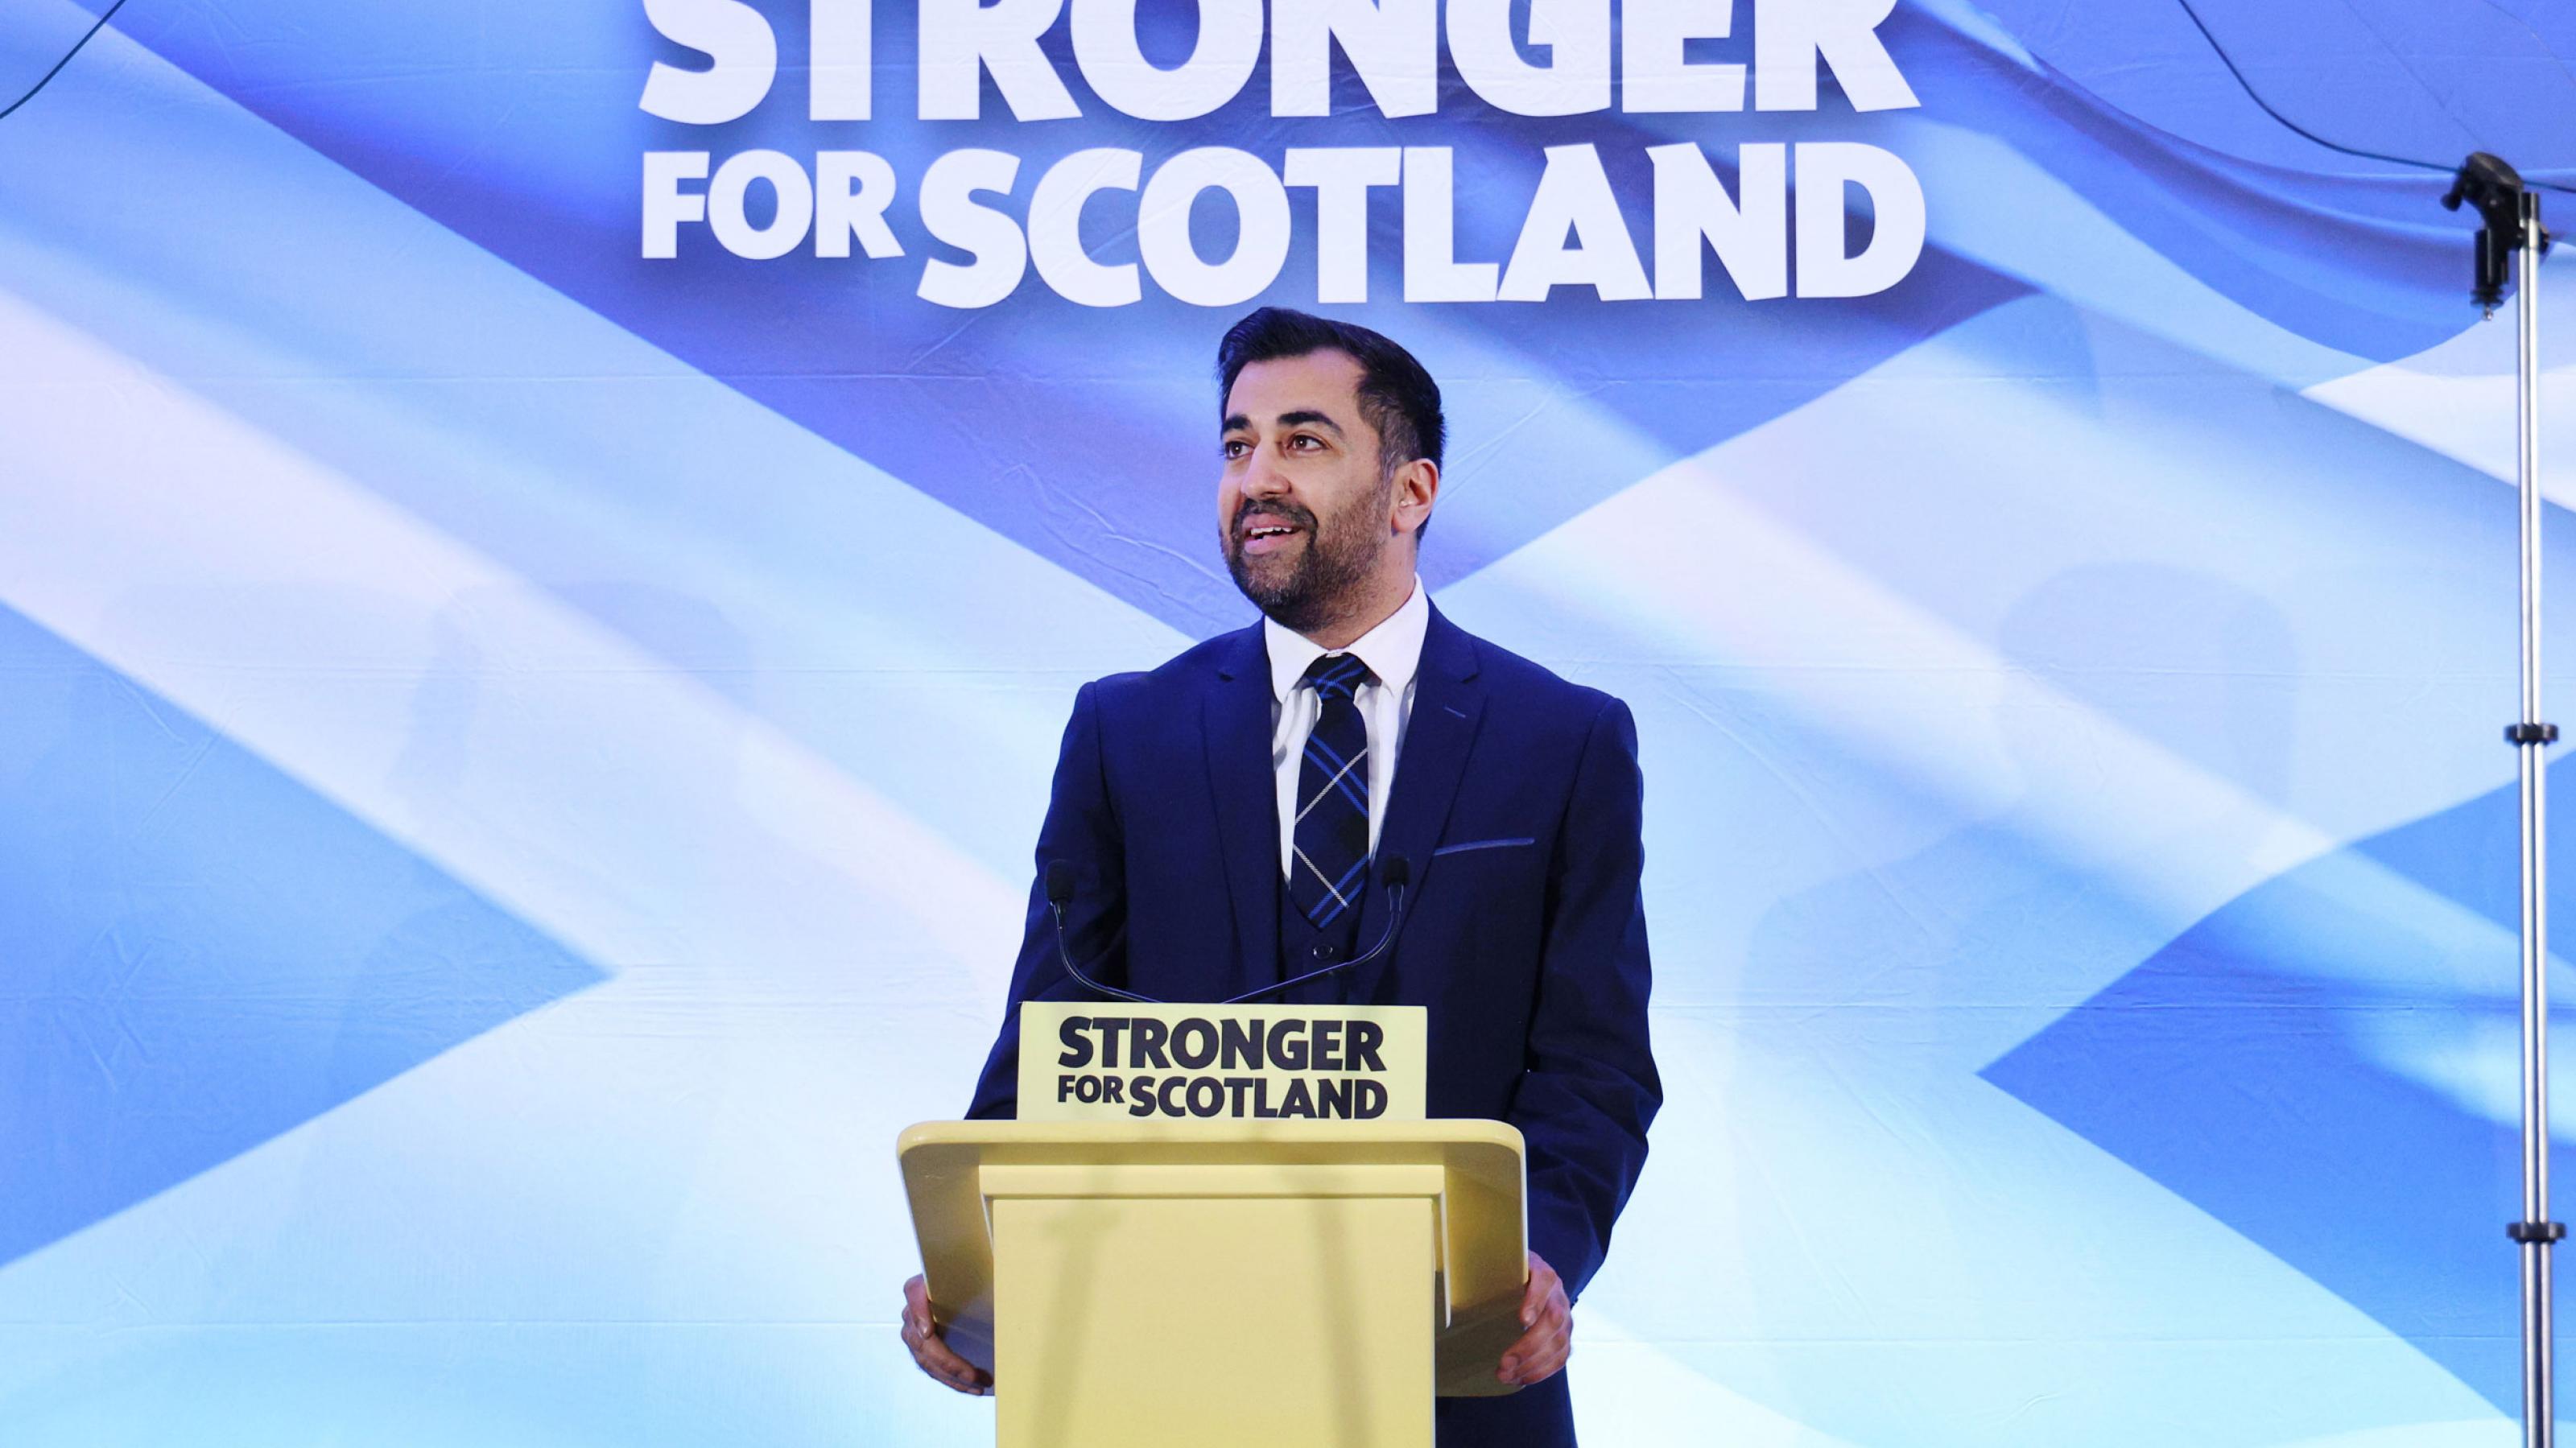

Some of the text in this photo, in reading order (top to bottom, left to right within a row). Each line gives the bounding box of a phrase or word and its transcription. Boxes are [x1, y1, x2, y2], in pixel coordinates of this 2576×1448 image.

[642, 142, 1926, 308] FOR SCOTLAND
[1058, 1016, 1387, 1071] STRONGER
[1057, 1075, 1388, 1120] FOR SCOTLAND
